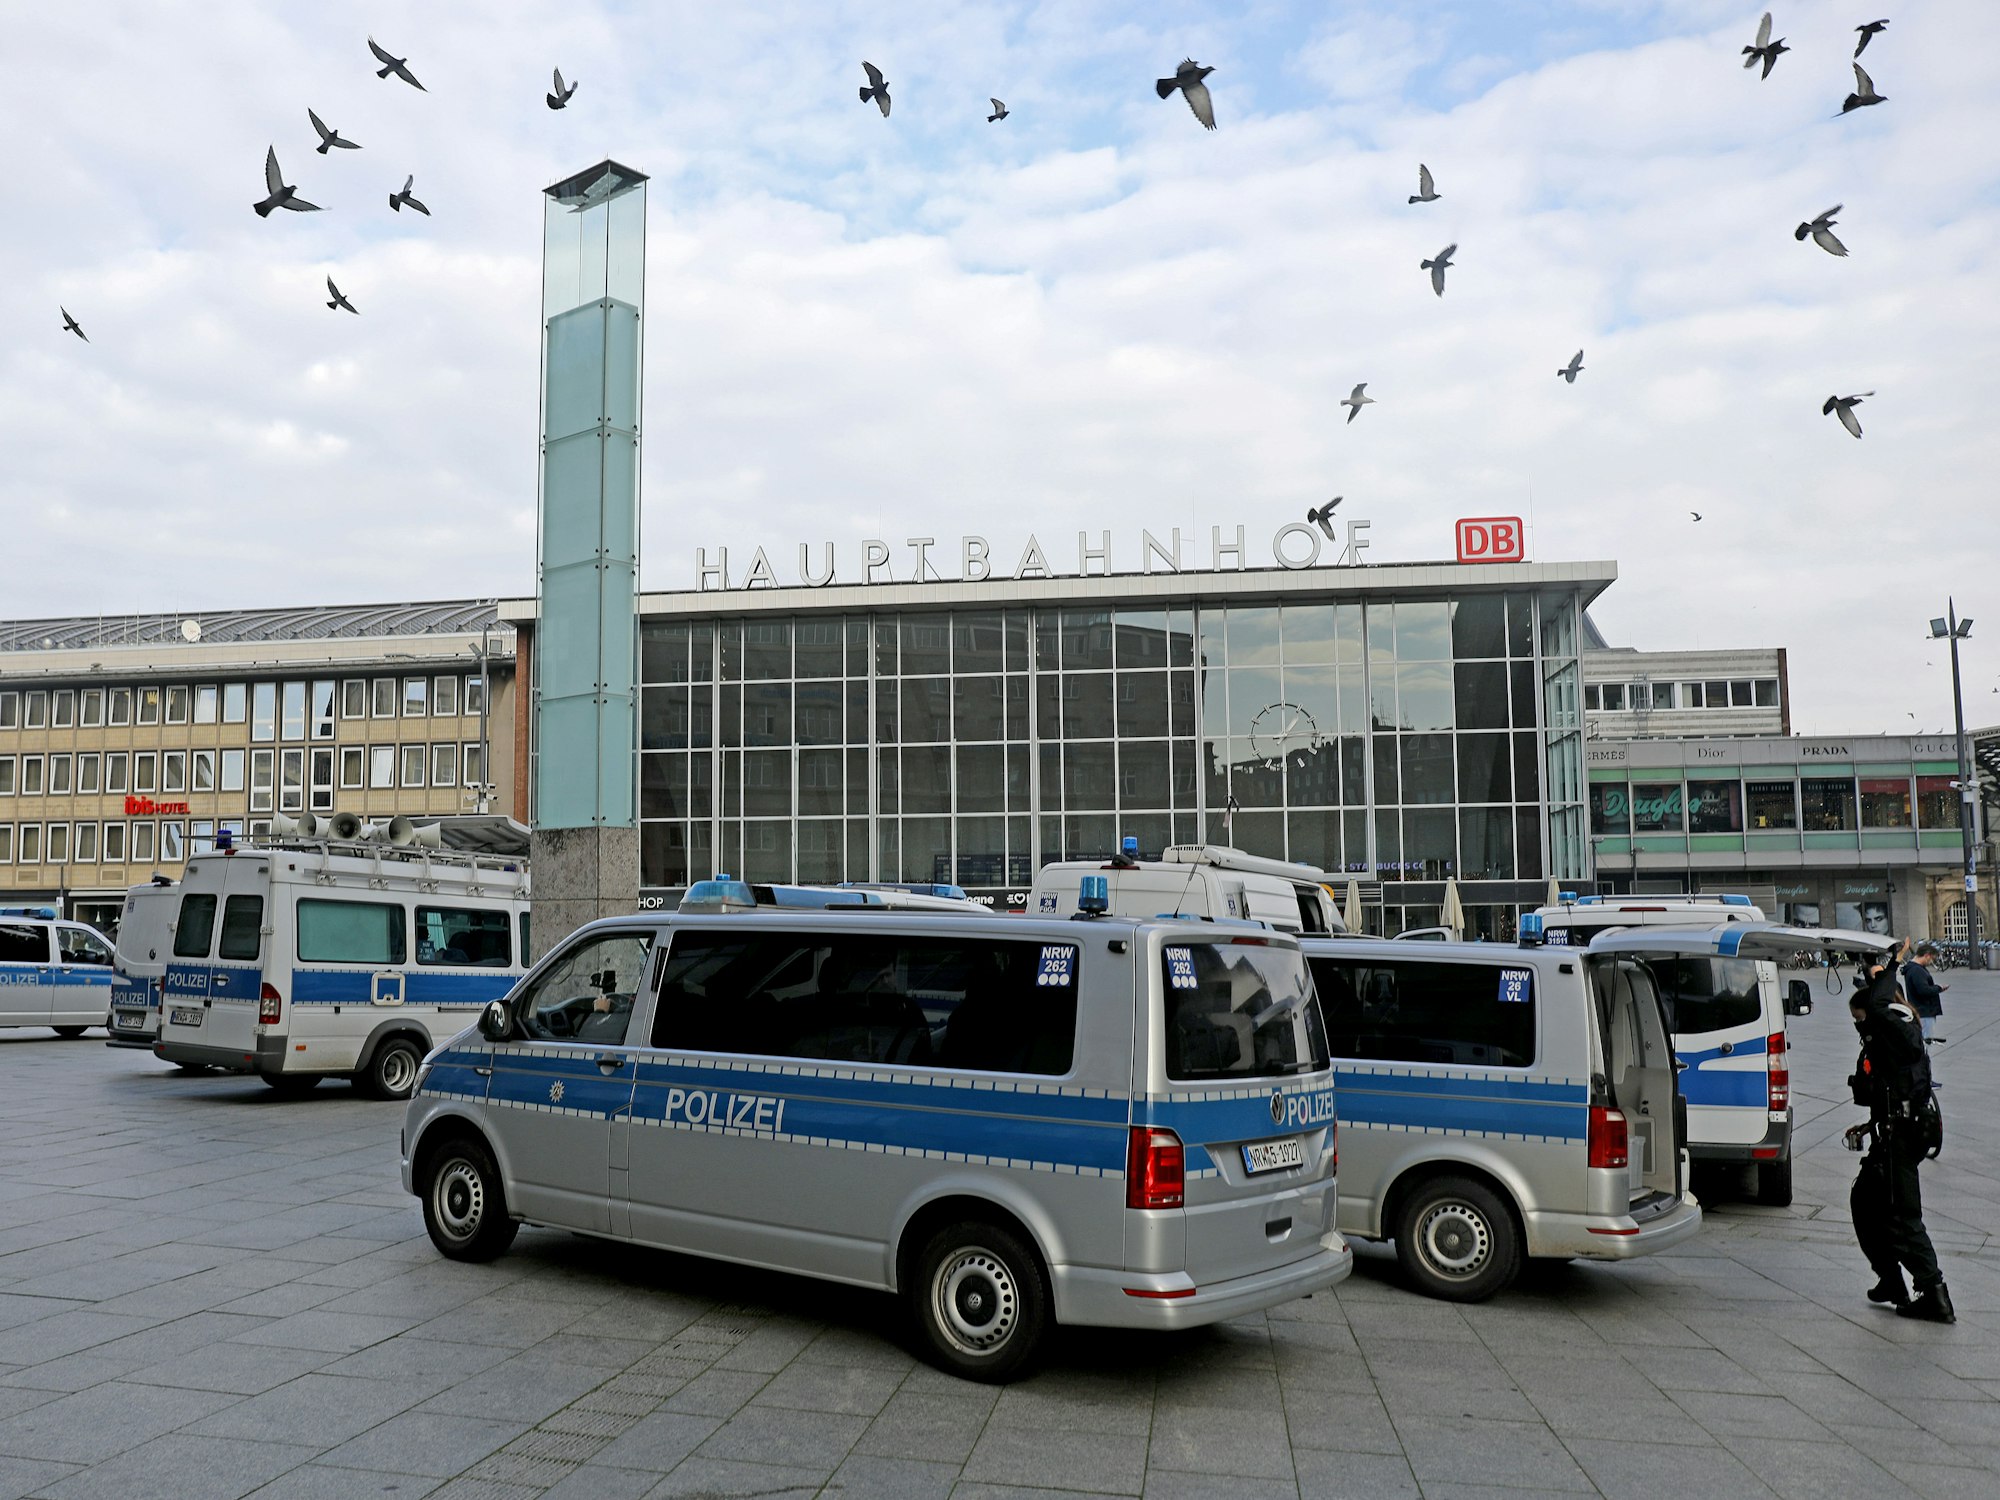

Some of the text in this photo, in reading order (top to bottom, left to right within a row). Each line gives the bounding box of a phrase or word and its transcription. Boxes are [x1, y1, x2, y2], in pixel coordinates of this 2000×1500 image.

[1465, 525, 1514, 555] DB
[696, 520, 1370, 592] HAUPTBAHNHOF
[1698, 748, 1726, 759] Dior
[1803, 746, 1849, 756] PRADA
[125, 795, 191, 815] ibis HOTEL
[1603, 788, 1702, 822] Douglas
[1775, 884, 1809, 897] Douglas
[1845, 883, 1880, 896] Douglas
[1547, 930, 1568, 938] NRW
[1042, 946, 1074, 960] NRW
[1166, 947, 1191, 961] NRW
[1044, 960, 1068, 973] 262
[1173, 961, 1192, 975] 262
[167, 972, 208, 989] POLIZEI
[1501, 970, 1530, 981] NRW
[1507, 981, 1522, 992] 26
[113, 991, 146, 1005] POLIZEI
[1506, 991, 1522, 1002] VL
[665, 1088, 786, 1133] POLIZEI
[1287, 1091, 1335, 1128] POLIZEI
[1248, 1142, 1300, 1169] NRW 5-1927
